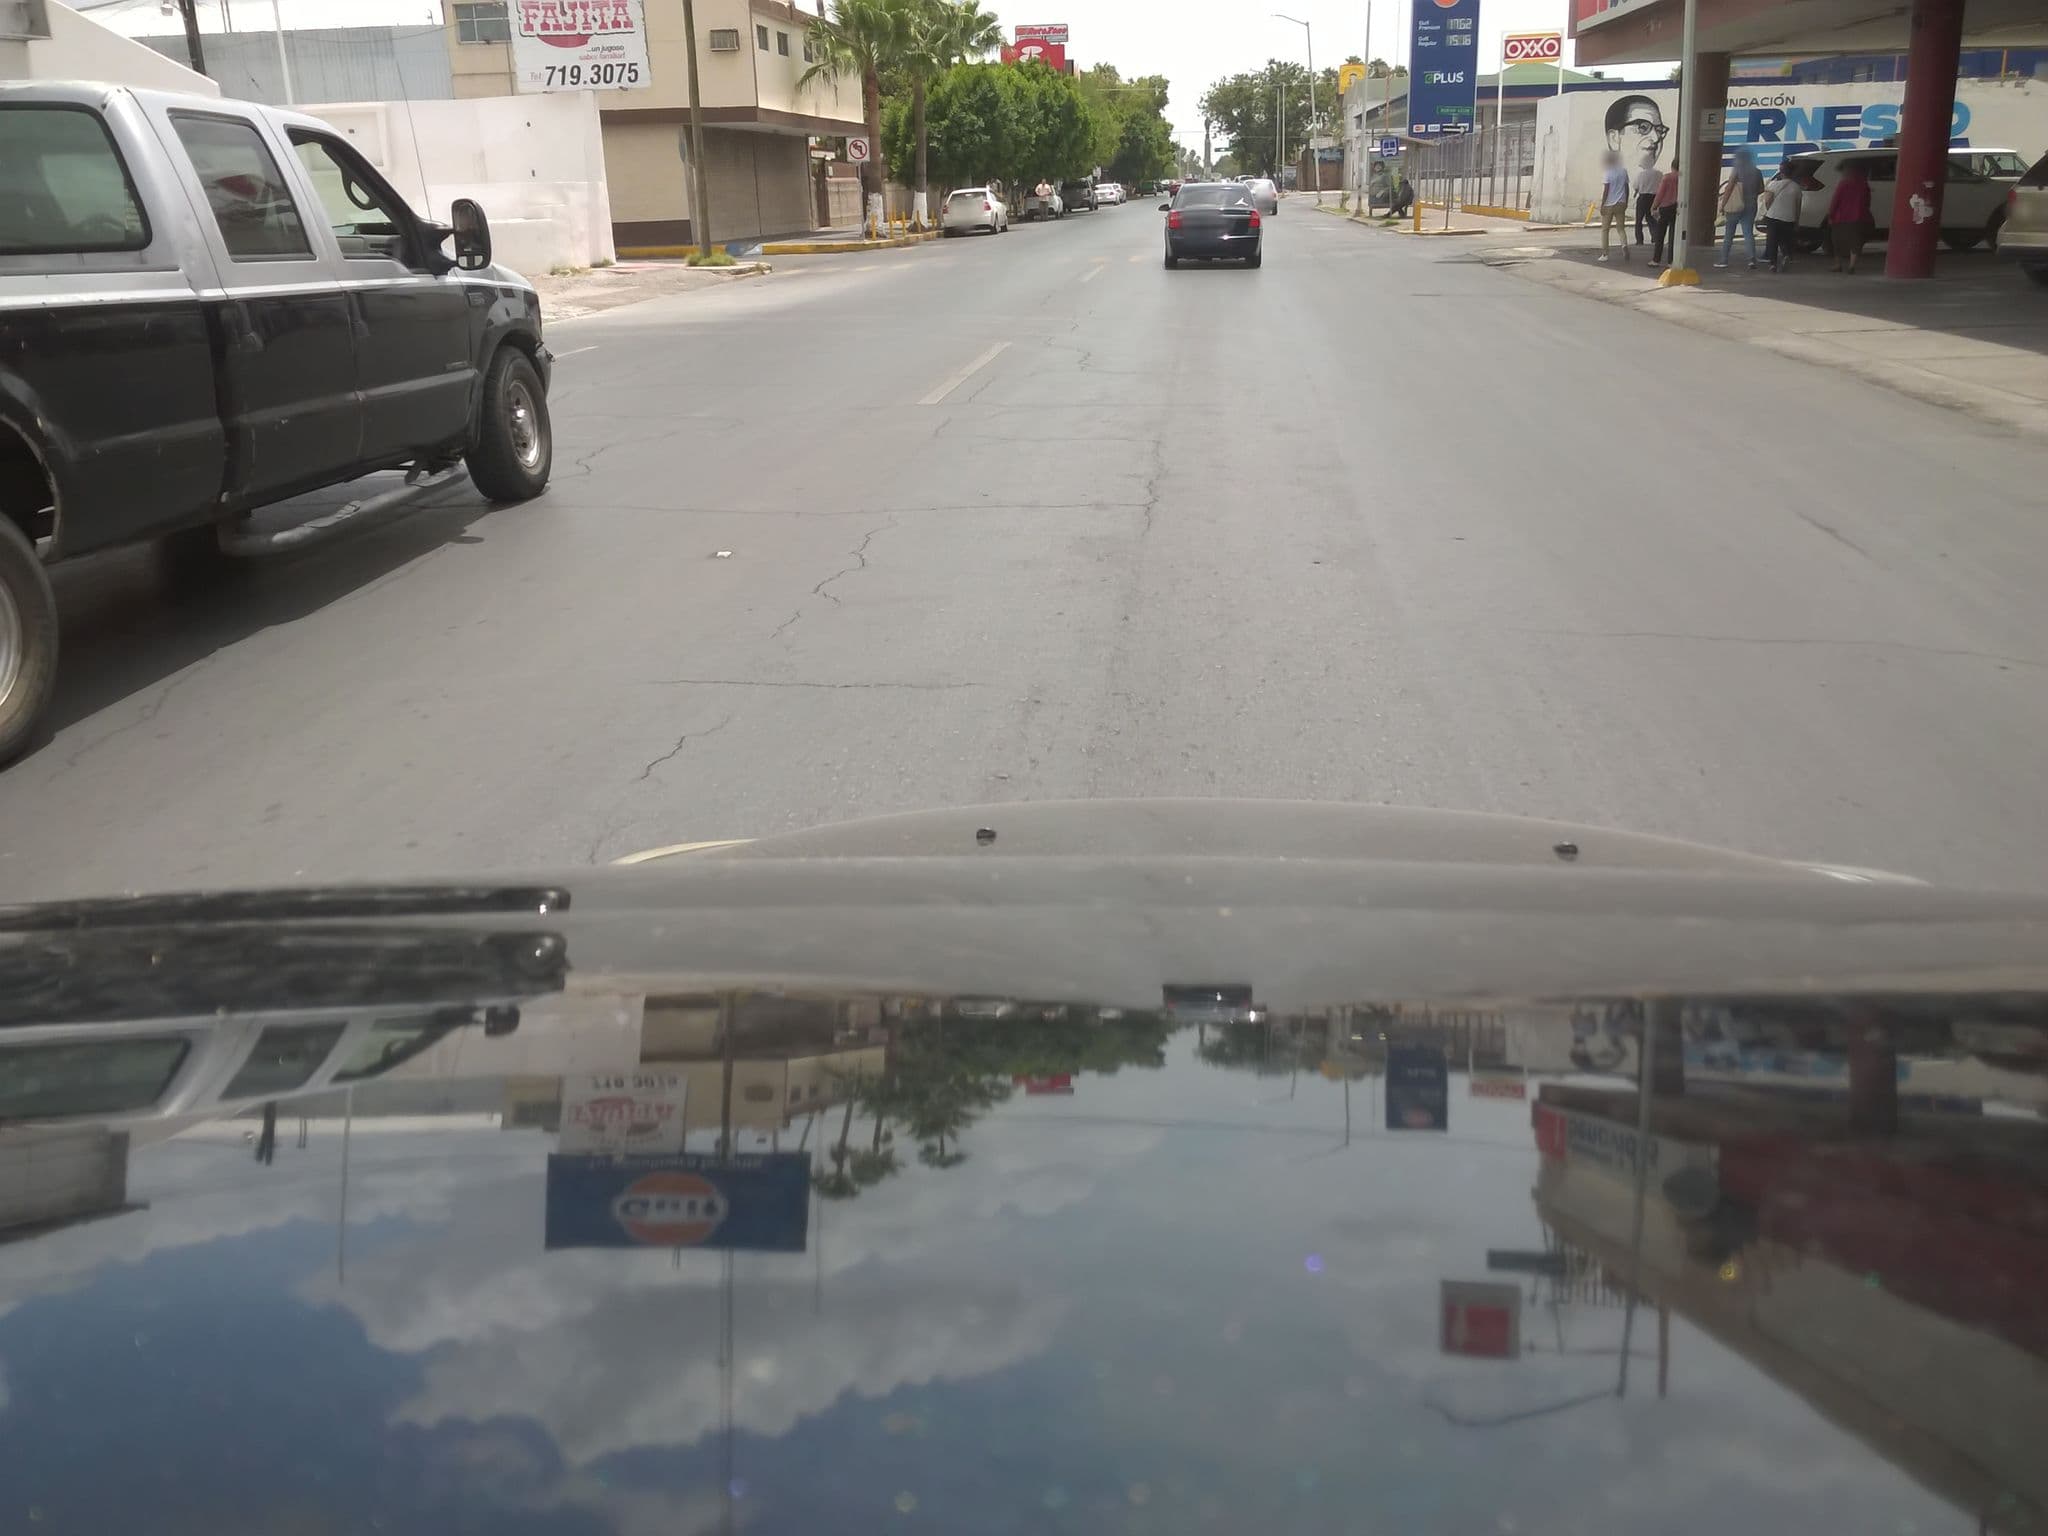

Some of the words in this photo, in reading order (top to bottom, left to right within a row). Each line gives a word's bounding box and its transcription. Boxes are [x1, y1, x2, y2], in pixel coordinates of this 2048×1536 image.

[521, 0, 634, 32] FAJITA
[601, 44, 625, 53] jugoso
[1505, 36, 1560, 58] OXXO
[545, 62, 639, 86] 719.3075
[1726, 93, 1796, 109] NDACIÓN
[1723, 101, 1971, 144] ERNESO
